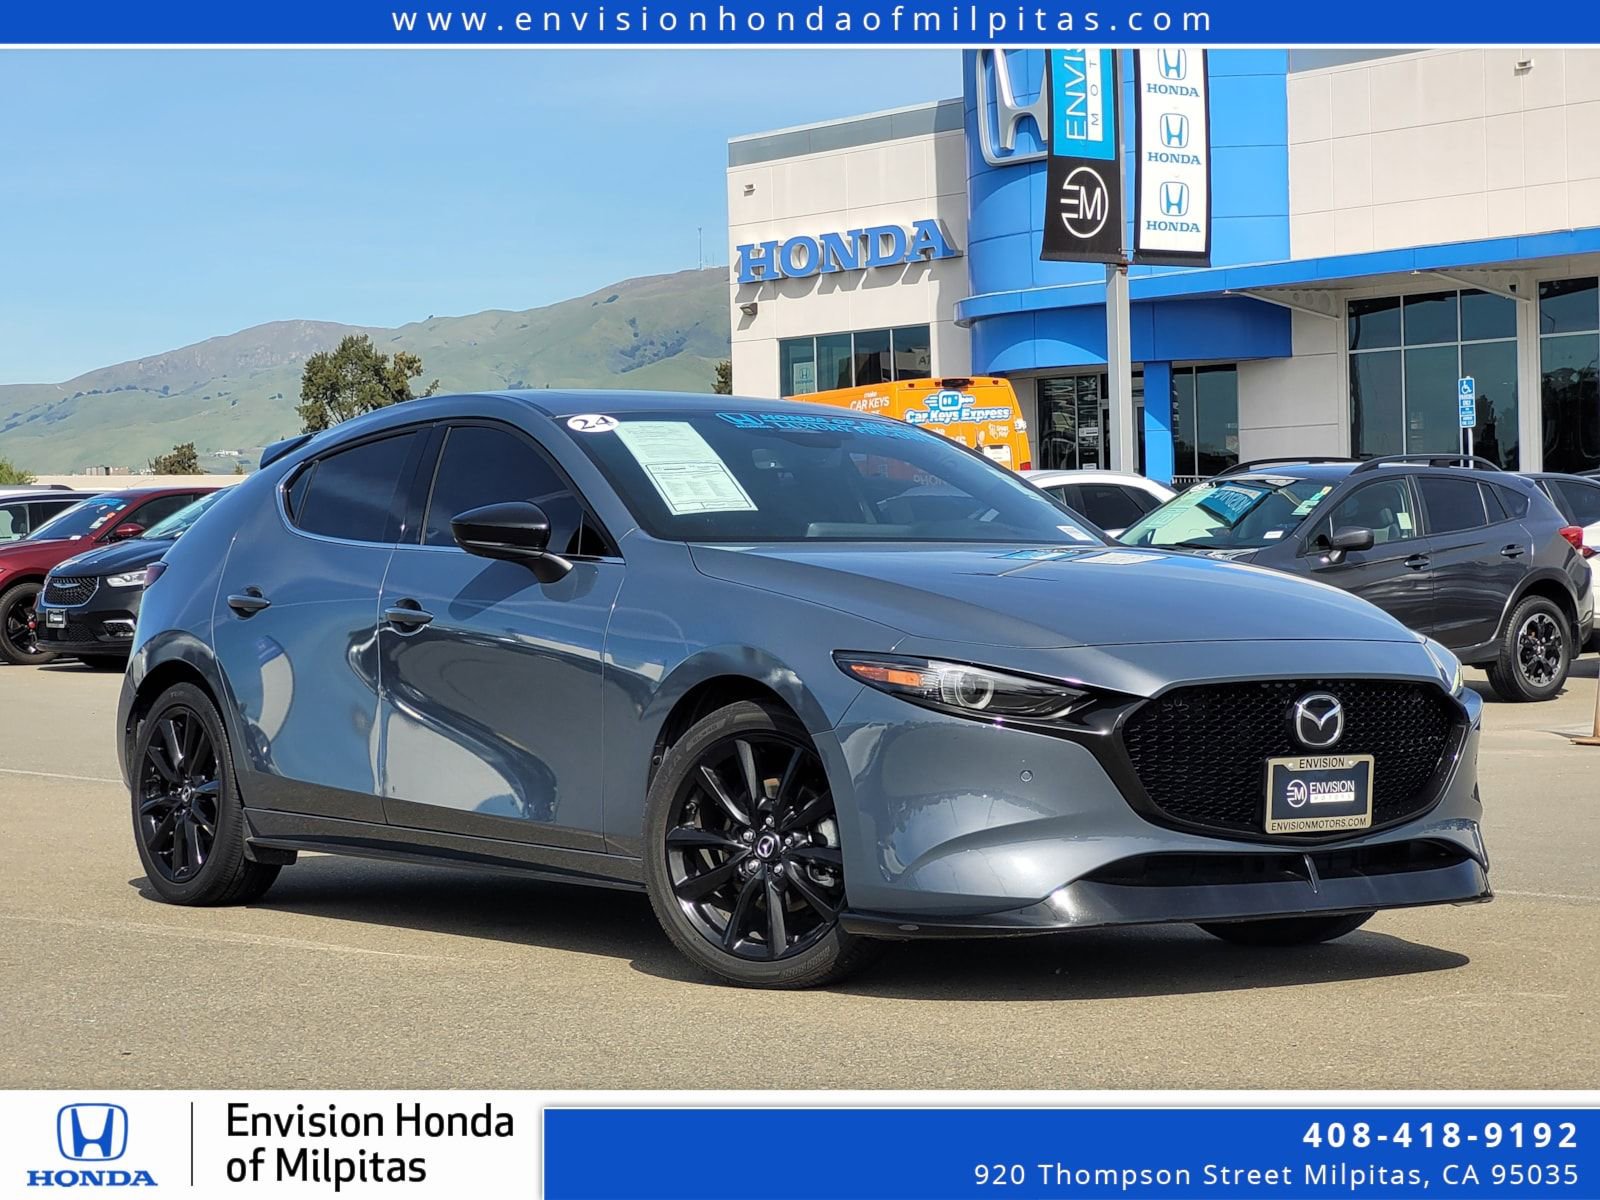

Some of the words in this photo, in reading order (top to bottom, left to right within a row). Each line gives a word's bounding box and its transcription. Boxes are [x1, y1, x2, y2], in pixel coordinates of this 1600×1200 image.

[1146, 83, 1200, 97] HONDA
[1147, 152, 1201, 165] HONDA
[1145, 220, 1201, 232] HONDA
[736, 218, 960, 284] HONDA
[849, 399, 868, 411] CAR
[869, 396, 890, 408] KEYS
[905, 410, 929, 423] Car
[930, 408, 959, 424] Keys
[960, 407, 1011, 422] Express
[572, 416, 613, 430] 24
[1299, 757, 1345, 769] ENVISION
[1309, 780, 1355, 794] ENVISION
[1271, 817, 1367, 831] ENVISIONMOTORS.COM
